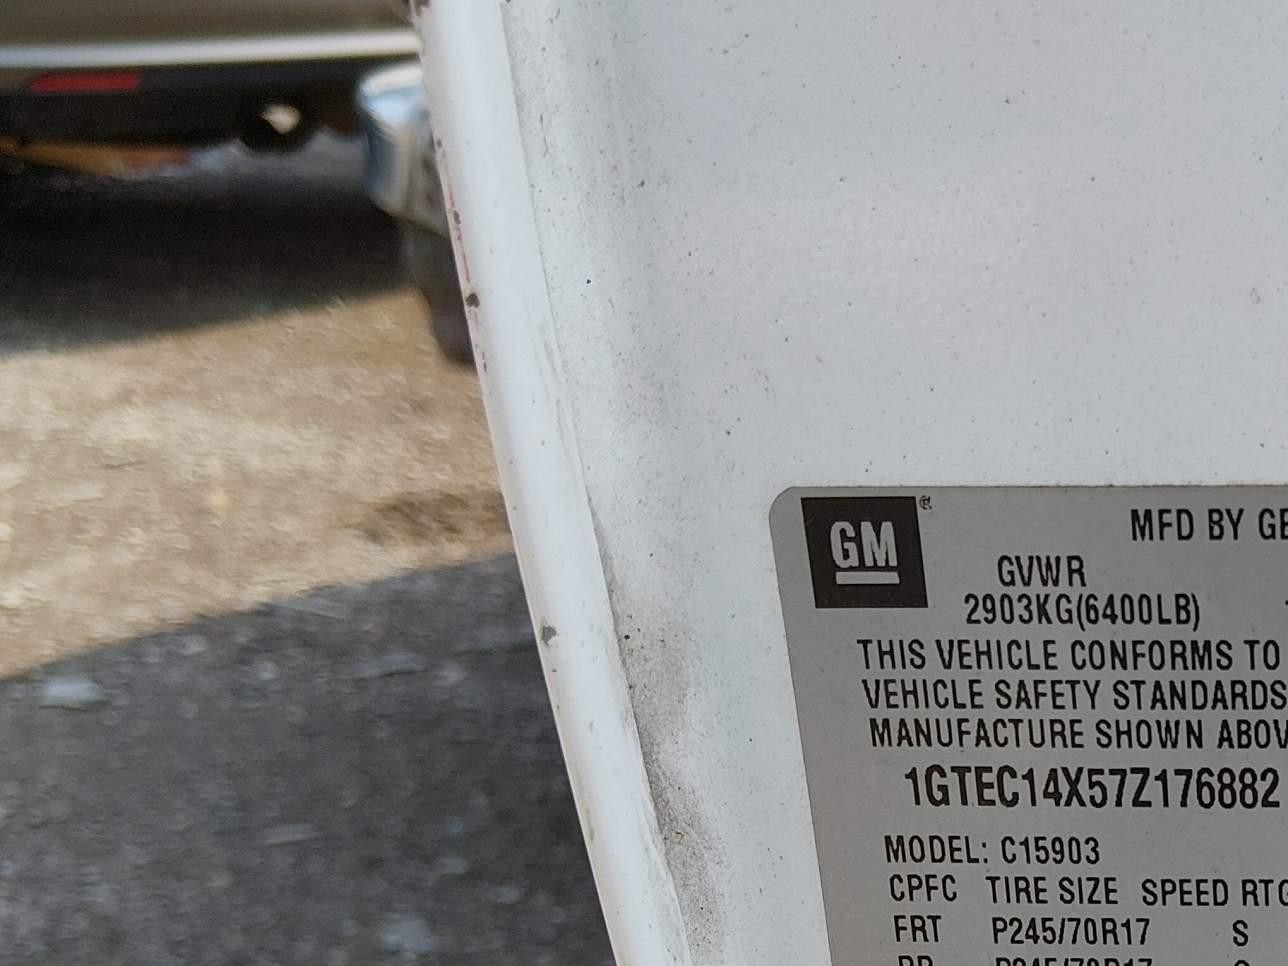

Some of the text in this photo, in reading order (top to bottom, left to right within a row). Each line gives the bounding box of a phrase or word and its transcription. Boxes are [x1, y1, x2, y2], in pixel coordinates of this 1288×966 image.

[1131, 509, 1193, 541] MFD
[1208, 508, 1244, 540] BY
[831, 522, 897, 568] GM
[998, 555, 1086, 587] GVWR
[965, 593, 1200, 632] 2903KG(6400LB)
[857, 639, 925, 669] THIS
[935, 639, 1058, 670] VEHICLE
[1071, 640, 1232, 670] CONFORMS
[1244, 640, 1279, 670] TO
[862, 679, 984, 709] VEHICLE
[995, 679, 1101, 709] SAFETY
[1113, 680, 1287, 710] STANDARDS
[869, 718, 1084, 748] MANUFACTURE
[1096, 719, 1203, 748] SHOWN
[905, 764, 1280, 809] 1GTEC14X57Z176882
[885, 835, 1099, 864] MODEL: C15903
[890, 874, 957, 901] CPFC
[986, 876, 1048, 904] TIRE
[1059, 877, 1118, 904] SIZE
[1142, 879, 1228, 906] SPEED
[894, 915, 941, 942] FRT
[992, 917, 1149, 945] P245/70R17
[1233, 920, 1248, 946] S
